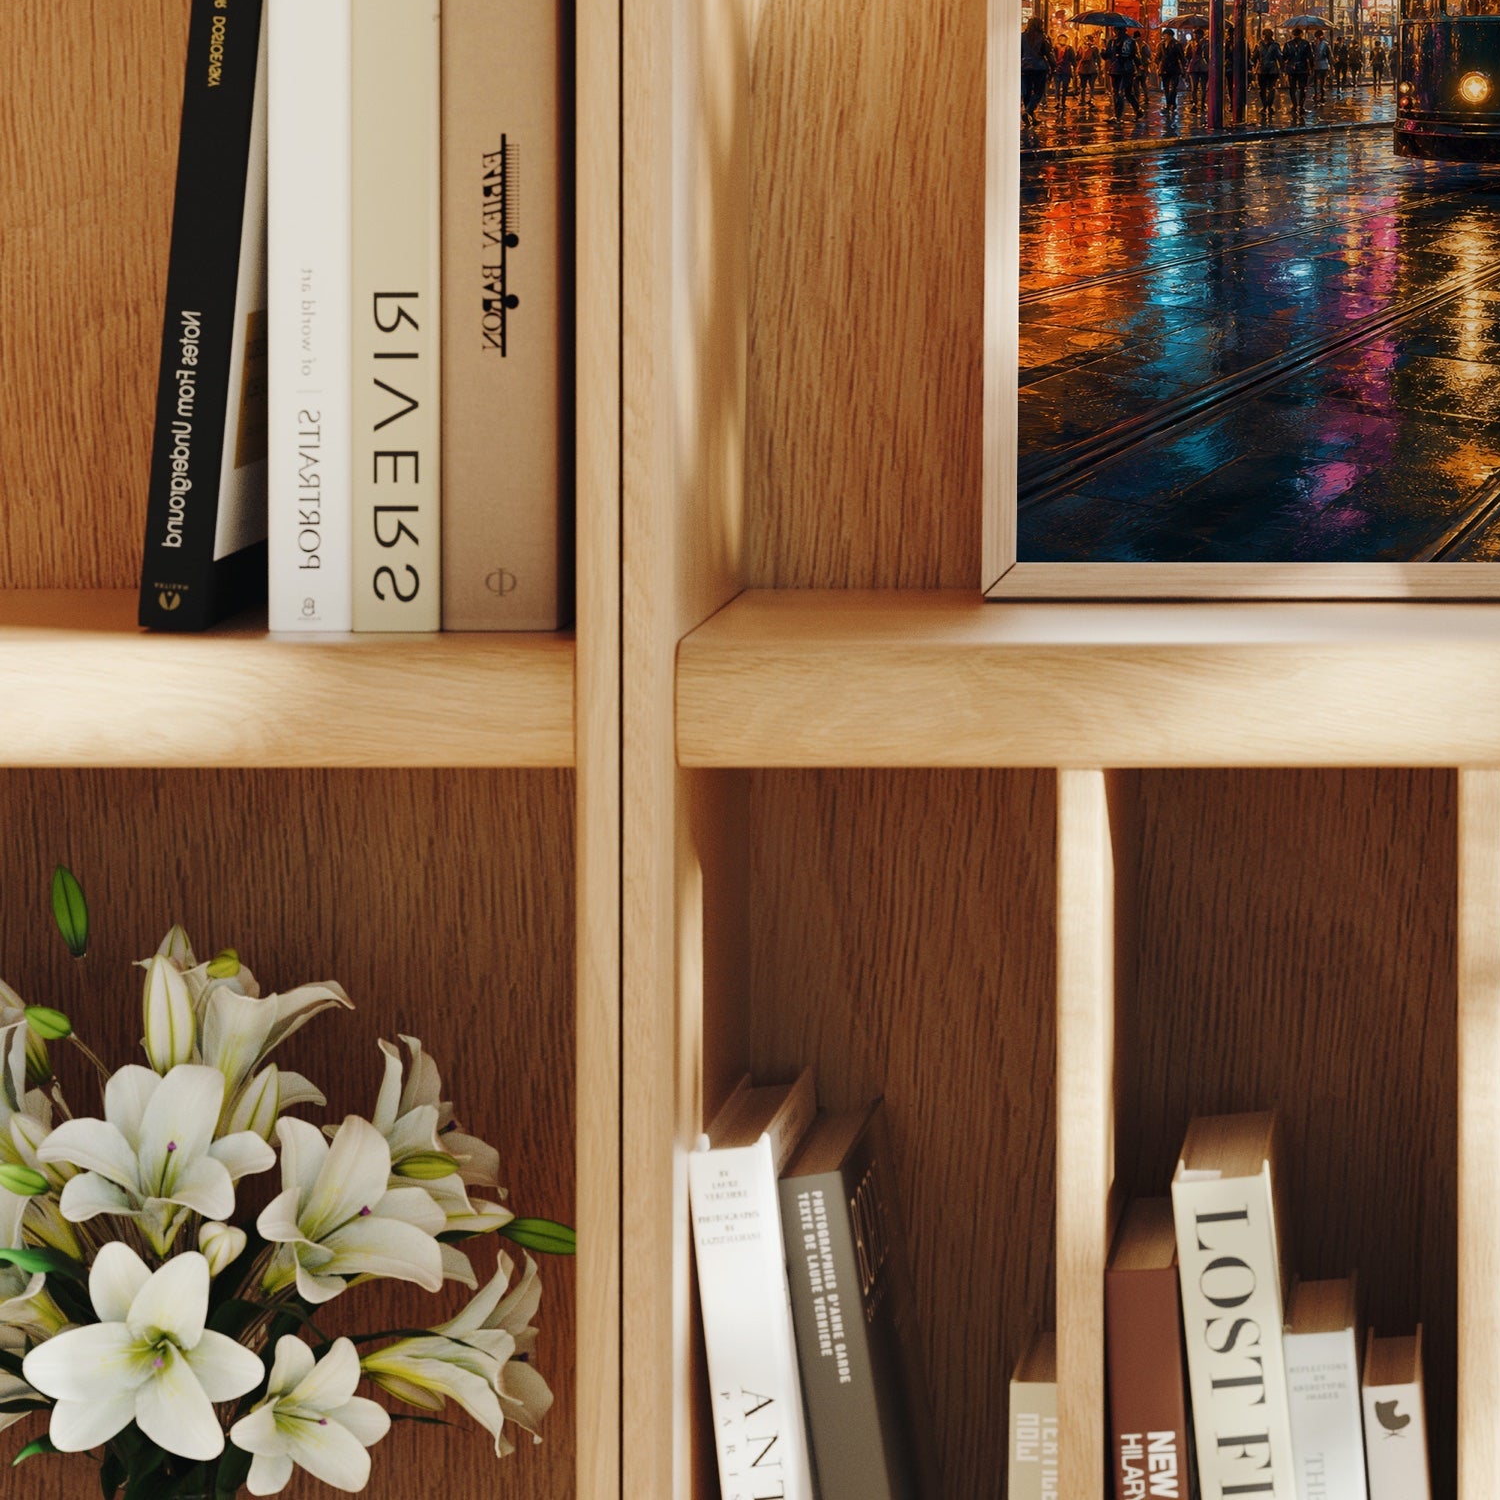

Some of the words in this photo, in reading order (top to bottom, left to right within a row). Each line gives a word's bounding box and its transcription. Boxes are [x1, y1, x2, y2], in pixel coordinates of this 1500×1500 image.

[797, 1192, 813, 1230] TEXTE
[804, 1234, 817, 1250] DE
[806, 1255, 823, 1293] LAURE
[811, 1190, 837, 1290] PHOTOGRAPHIES
[834, 1343, 851, 1384] GARDE
[1194, 1203, 1266, 1406] LOST
[1015, 1413, 1039, 1462] NOW
[1147, 1431, 1179, 1498] NEW
